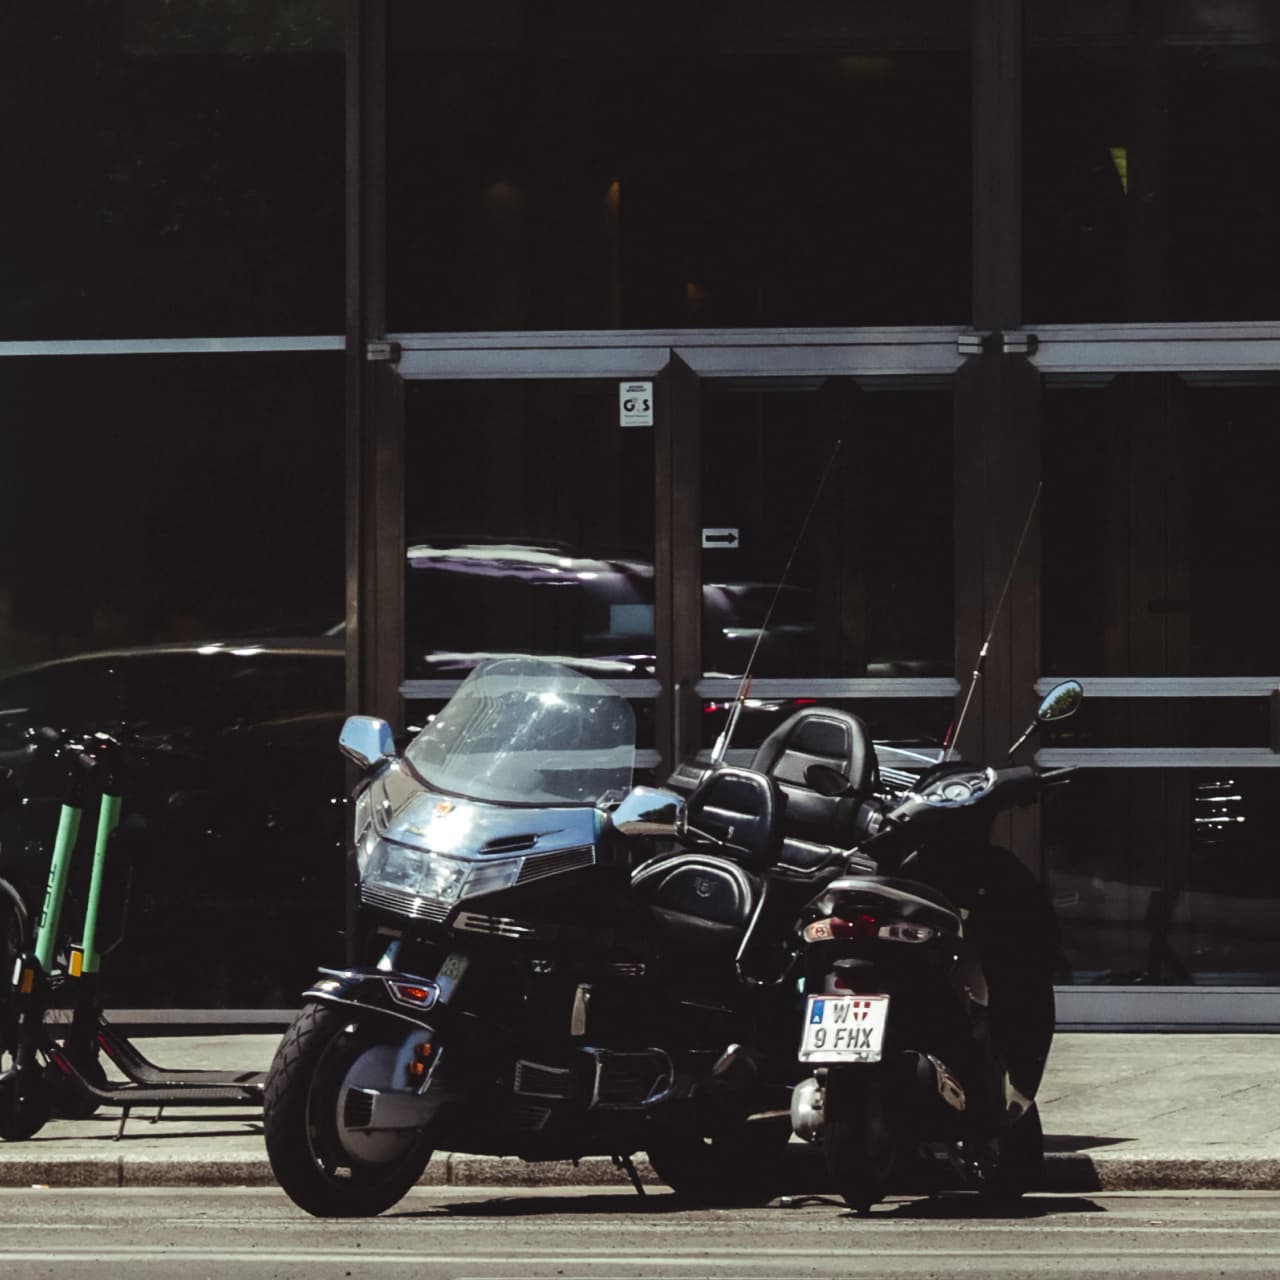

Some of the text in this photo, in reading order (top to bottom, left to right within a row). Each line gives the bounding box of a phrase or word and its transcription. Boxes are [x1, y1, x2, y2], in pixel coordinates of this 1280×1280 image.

[833, 1002, 851, 1024] W
[814, 1027, 874, 1049] 9 FHX
